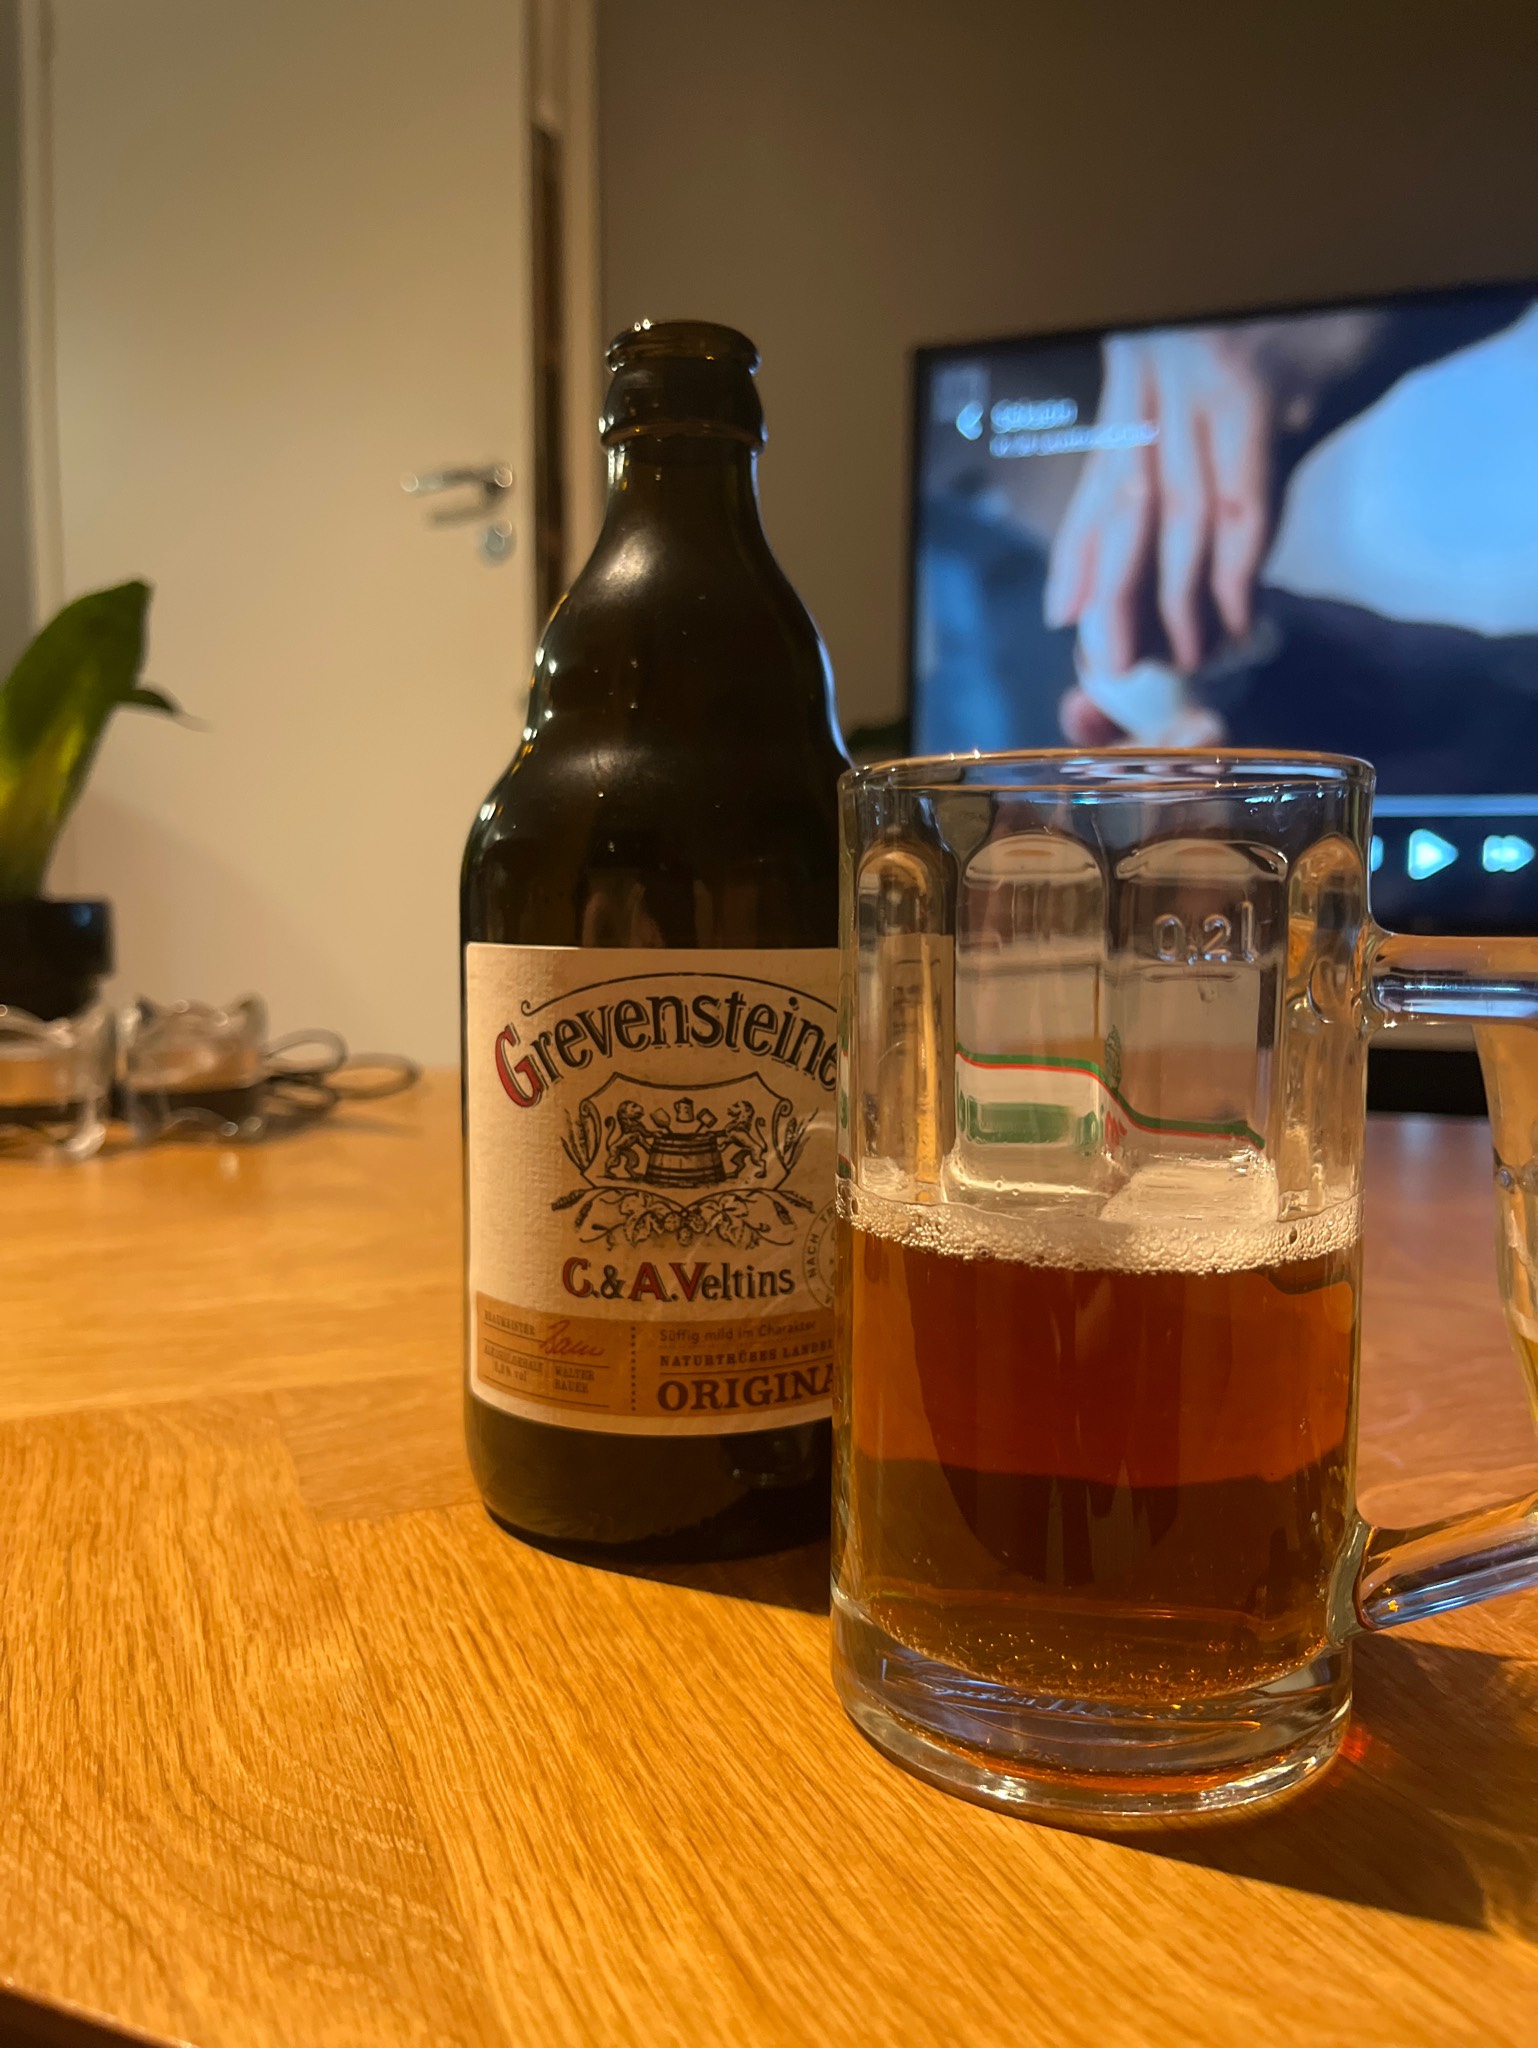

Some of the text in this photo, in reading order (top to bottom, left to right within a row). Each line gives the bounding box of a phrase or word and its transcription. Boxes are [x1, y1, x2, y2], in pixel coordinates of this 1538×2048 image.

[495, 990, 838, 1108] Grevensteine
[659, 1319, 817, 1345] Süffig mild im Charakter
[659, 1347, 778, 1368] NATURTRÜBES
[554, 1366, 596, 1382] WALTER
